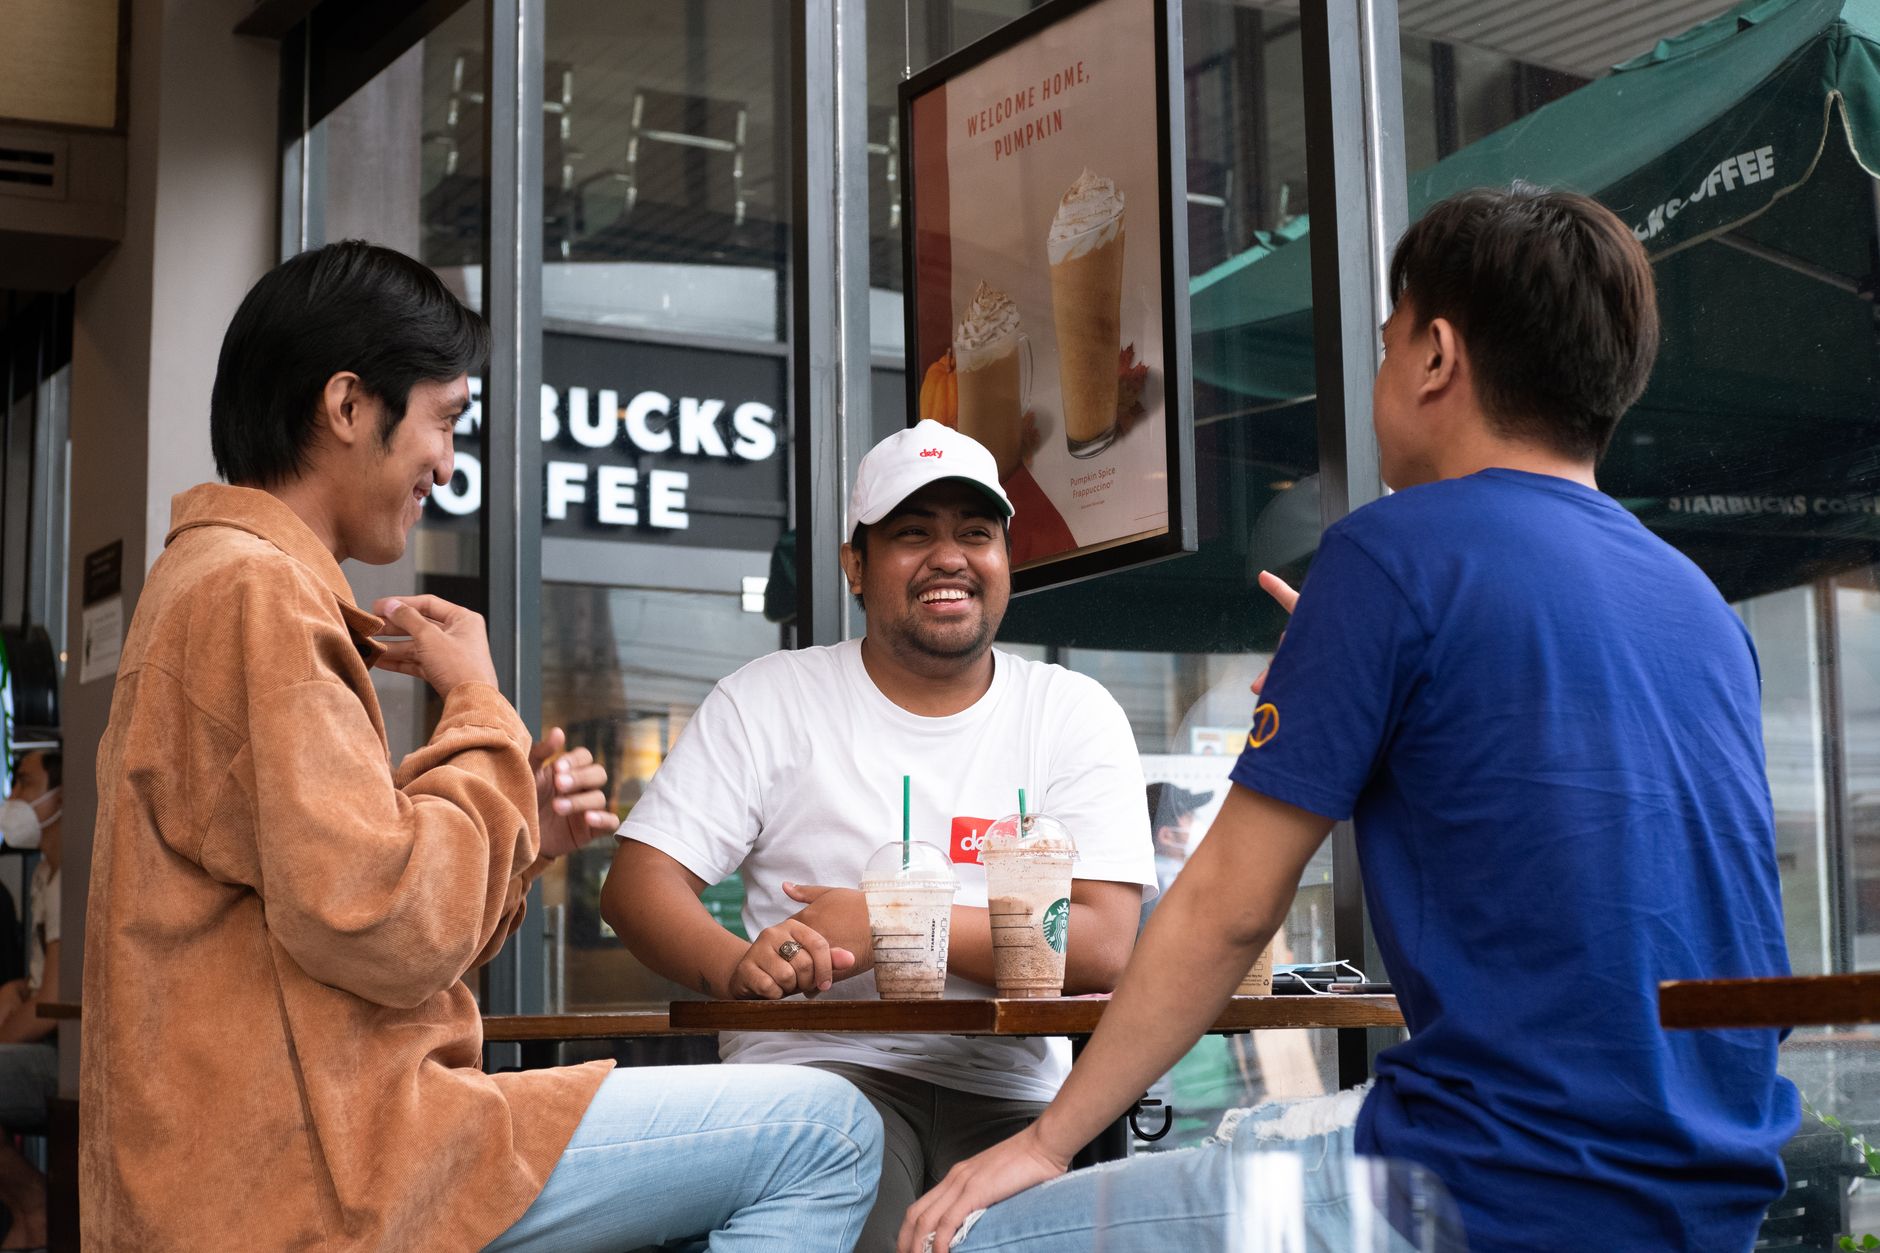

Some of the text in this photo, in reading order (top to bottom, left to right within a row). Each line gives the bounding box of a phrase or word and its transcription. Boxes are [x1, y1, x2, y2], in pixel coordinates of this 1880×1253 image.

[967, 61, 1090, 138] WELCOME HOME,
[995, 109, 1062, 161] PUMPKIN
[920, 448, 943, 459] defy
[1070, 467, 1115, 487] Pumpkin Spice
